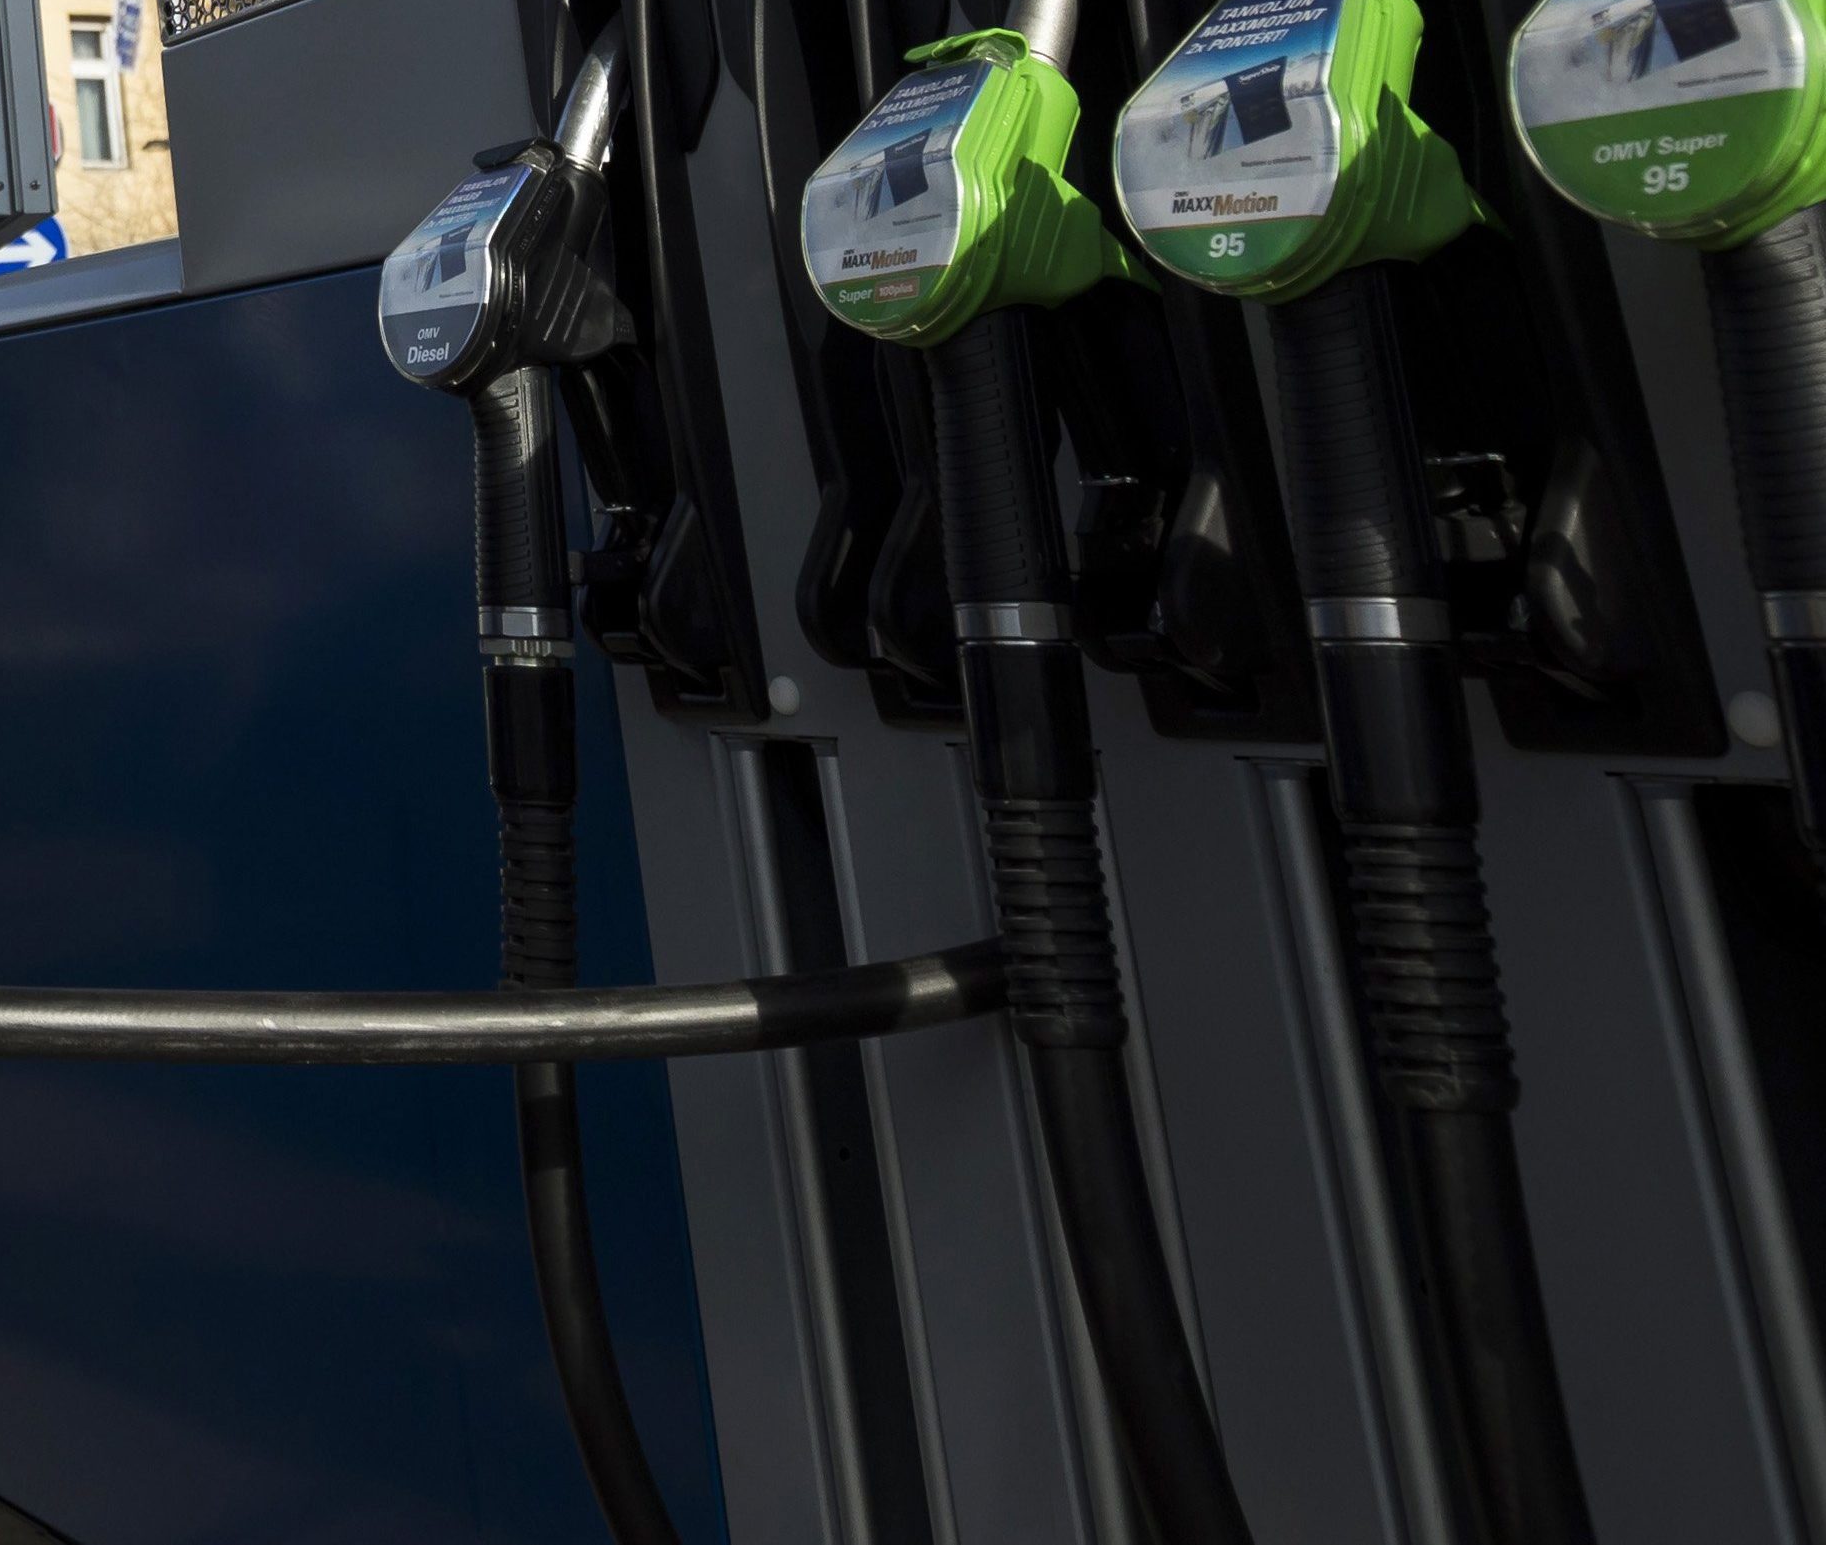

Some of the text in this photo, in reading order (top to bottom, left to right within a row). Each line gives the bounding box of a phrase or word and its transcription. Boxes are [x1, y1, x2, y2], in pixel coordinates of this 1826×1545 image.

[1201, 7, 1328, 38] MAXXMOTIONT
[1593, 132, 1729, 164] OMV Super
[1642, 162, 1690, 195] 95
[1208, 232, 1246, 259] 95
[838, 287, 873, 305] Super
[417, 326, 440, 340] OMV
[407, 342, 450, 365] Diesel
